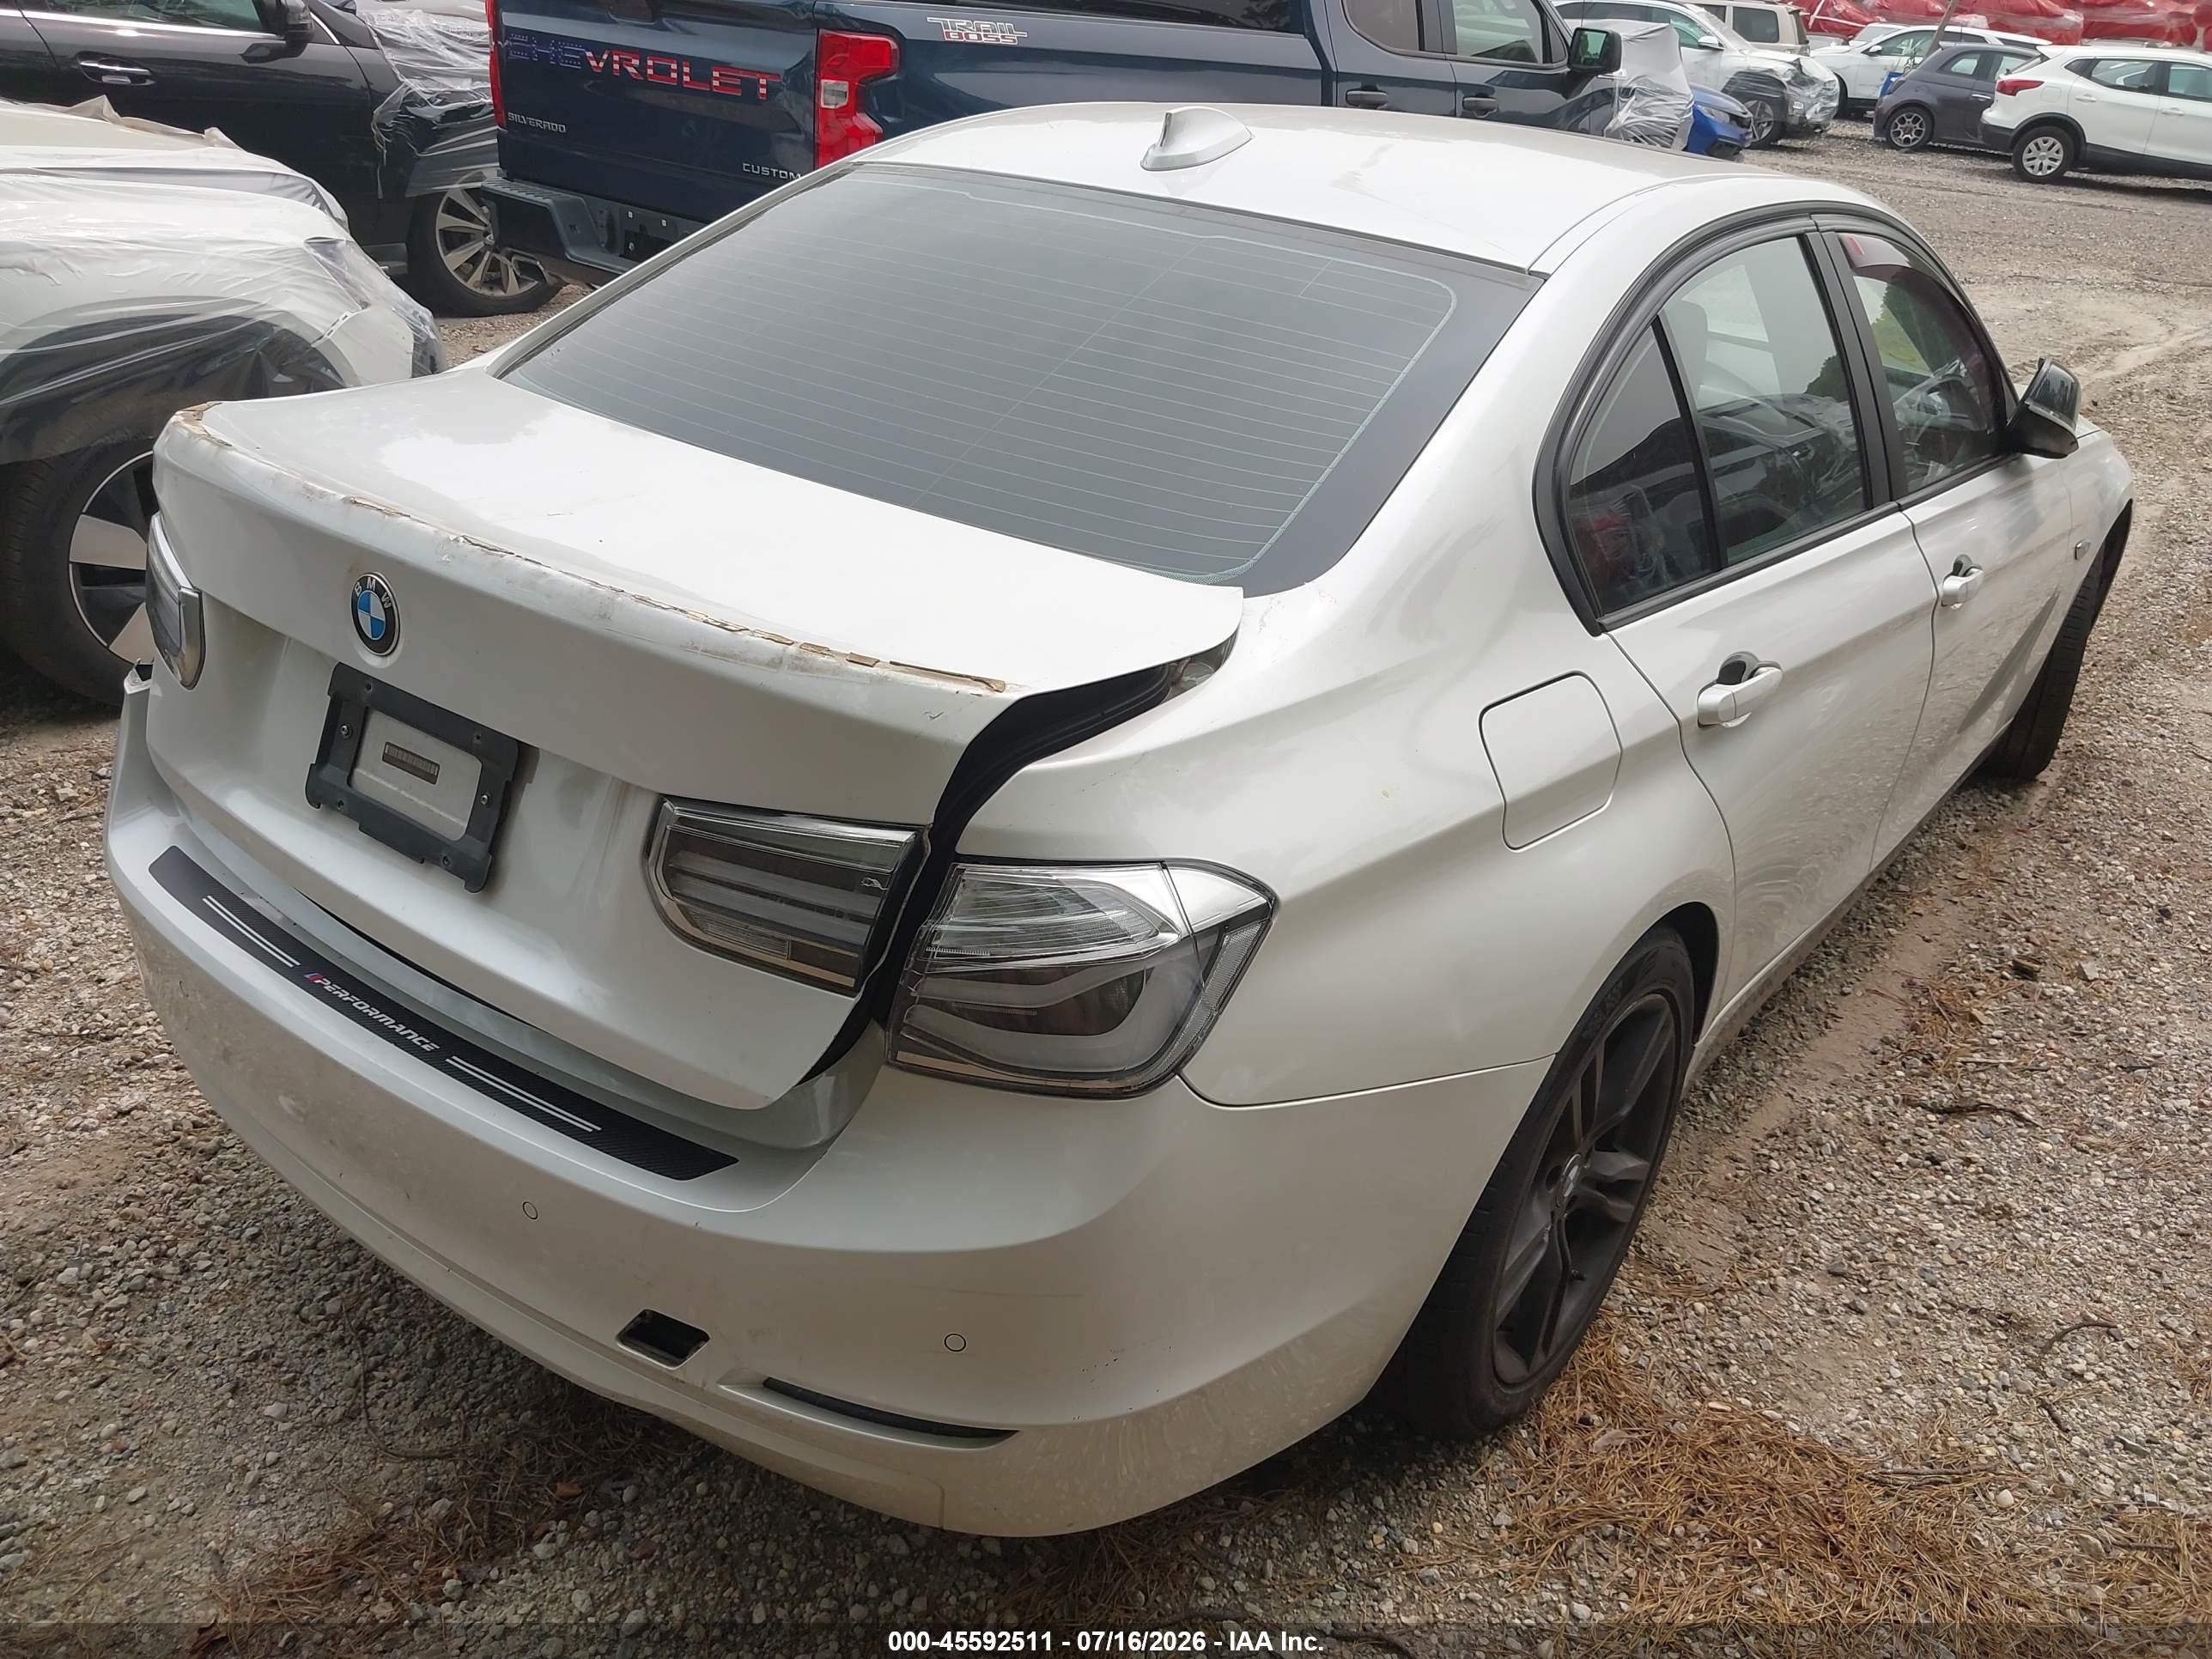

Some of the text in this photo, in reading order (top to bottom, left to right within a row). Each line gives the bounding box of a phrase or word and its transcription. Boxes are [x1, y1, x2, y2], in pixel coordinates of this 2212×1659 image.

[927, 17, 1028, 37] TRAIL
[943, 31, 1018, 45] BOSS
[507, 32, 781, 100] CHEVROLET
[507, 112, 567, 133] SILVERADO
[742, 163, 801, 179] CUSTOM
[354, 576, 392, 609] BMW
[313, 978, 440, 1051] PERFORMANCE
